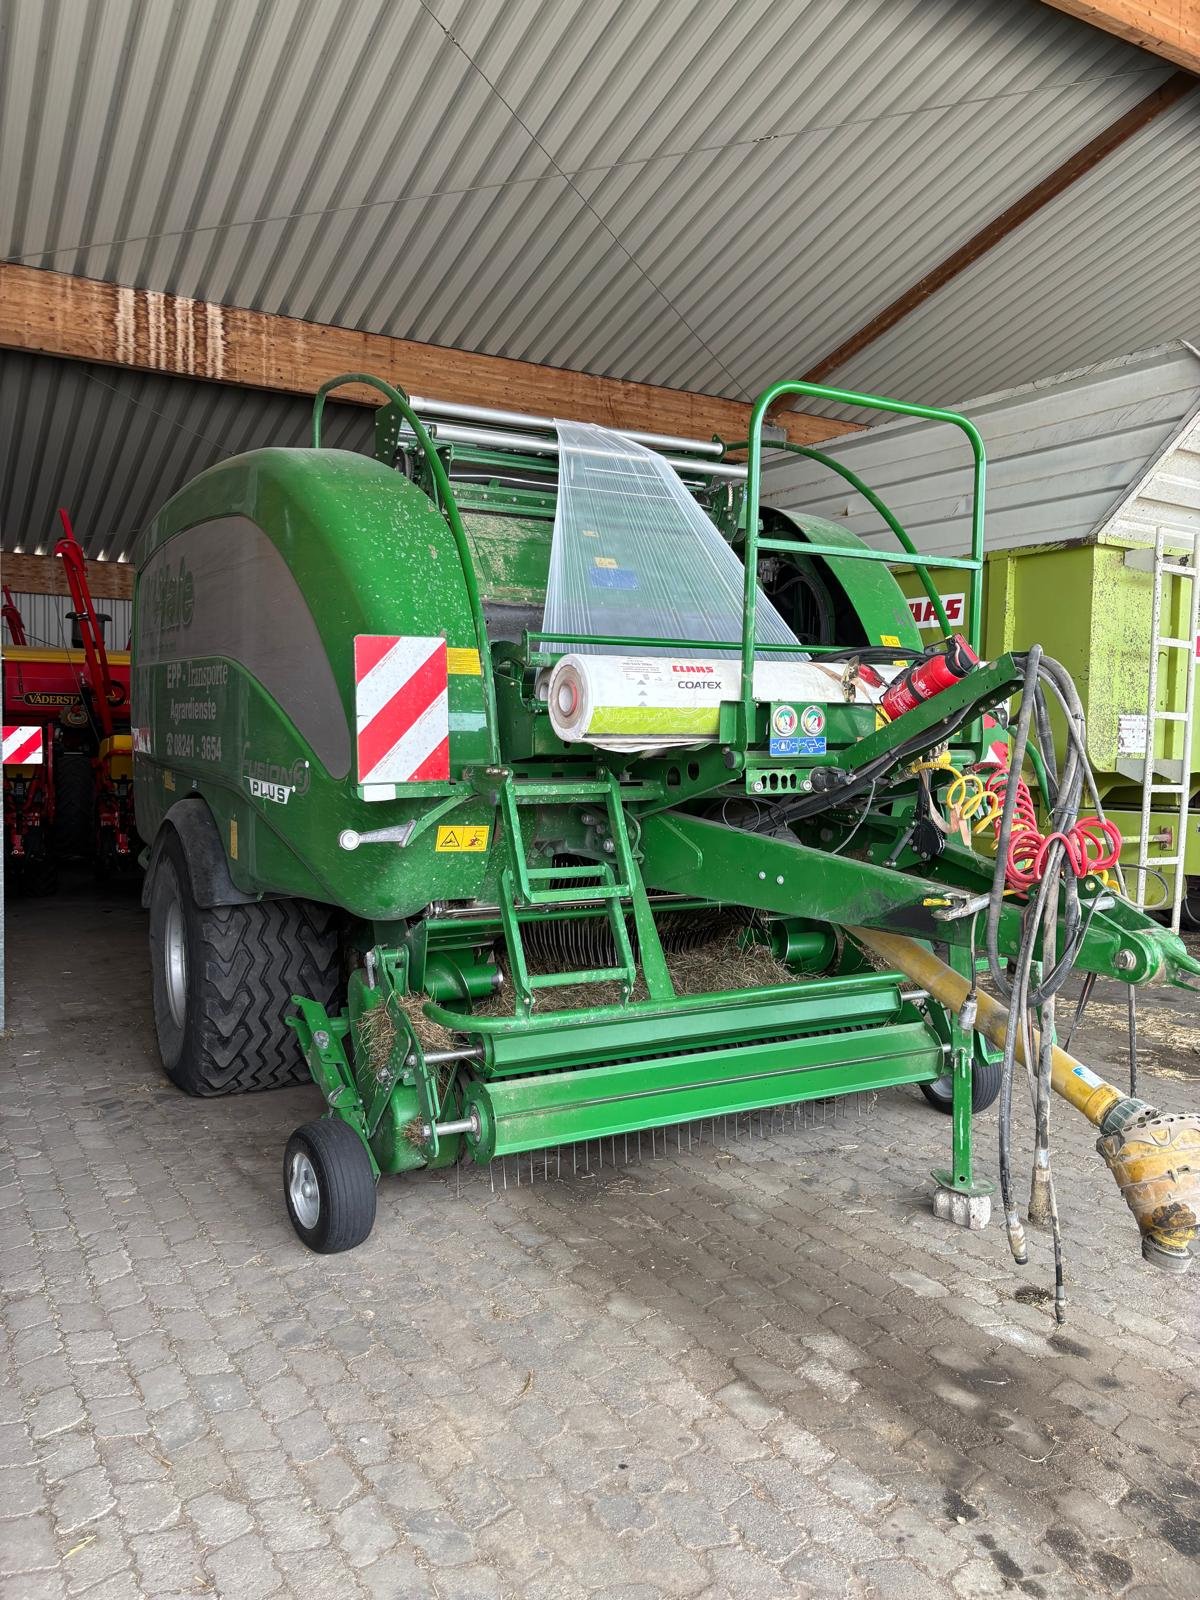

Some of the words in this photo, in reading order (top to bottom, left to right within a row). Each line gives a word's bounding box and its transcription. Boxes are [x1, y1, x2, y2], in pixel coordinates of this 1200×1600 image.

[909, 599, 962, 622] AAS
[166, 663, 181, 689] EPP
[186, 660, 229, 694] Transporte
[671, 665, 715, 674] CLAAS
[677, 680, 722, 690] COATEX
[28, 693, 81, 706] VÄDERSTA
[169, 697, 218, 726] Agrardienste
[174, 733, 195, 758] 08241
[201, 735, 222, 761] 3654
[252, 781, 286, 803] PLUS
